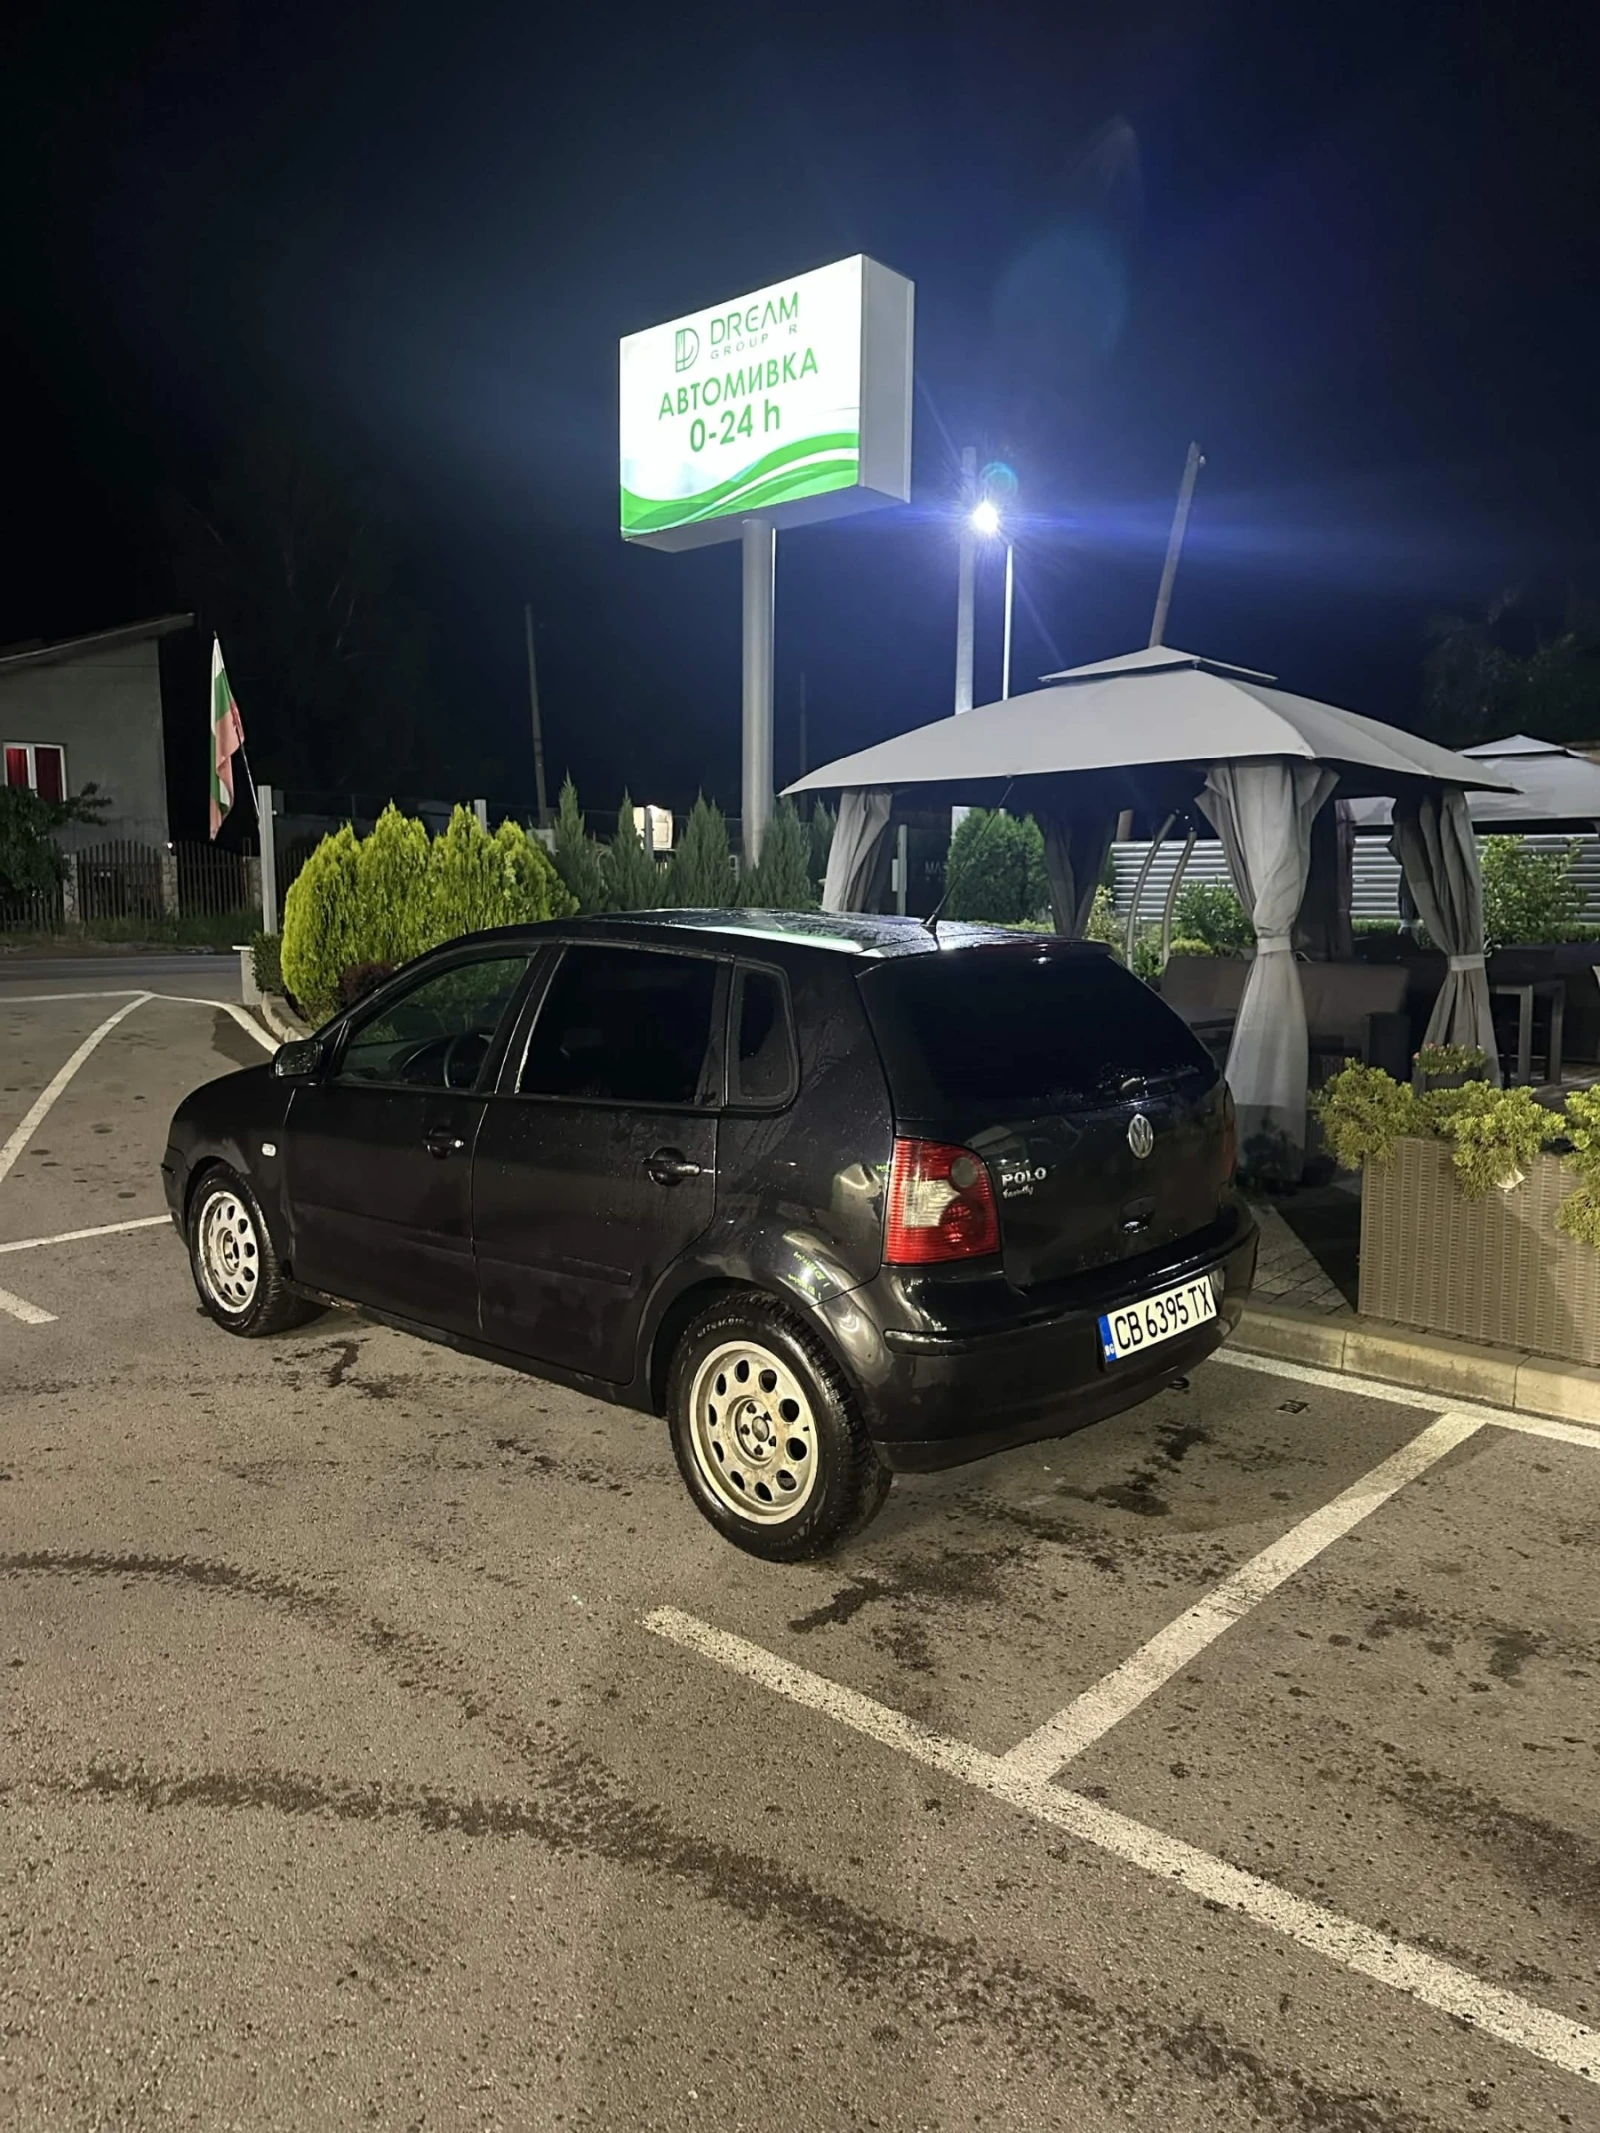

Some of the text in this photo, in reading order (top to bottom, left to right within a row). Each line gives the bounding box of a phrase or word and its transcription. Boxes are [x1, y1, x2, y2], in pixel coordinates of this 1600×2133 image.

[710, 291, 798, 345] DREAM
[710, 333, 769, 360] GROUP
[658, 347, 819, 421] АВТОМИВКА
[690, 399, 780, 452] 0-24 h
[1001, 1166, 1047, 1187] POLO
[1114, 1281, 1213, 1350] CB 6395 TX
